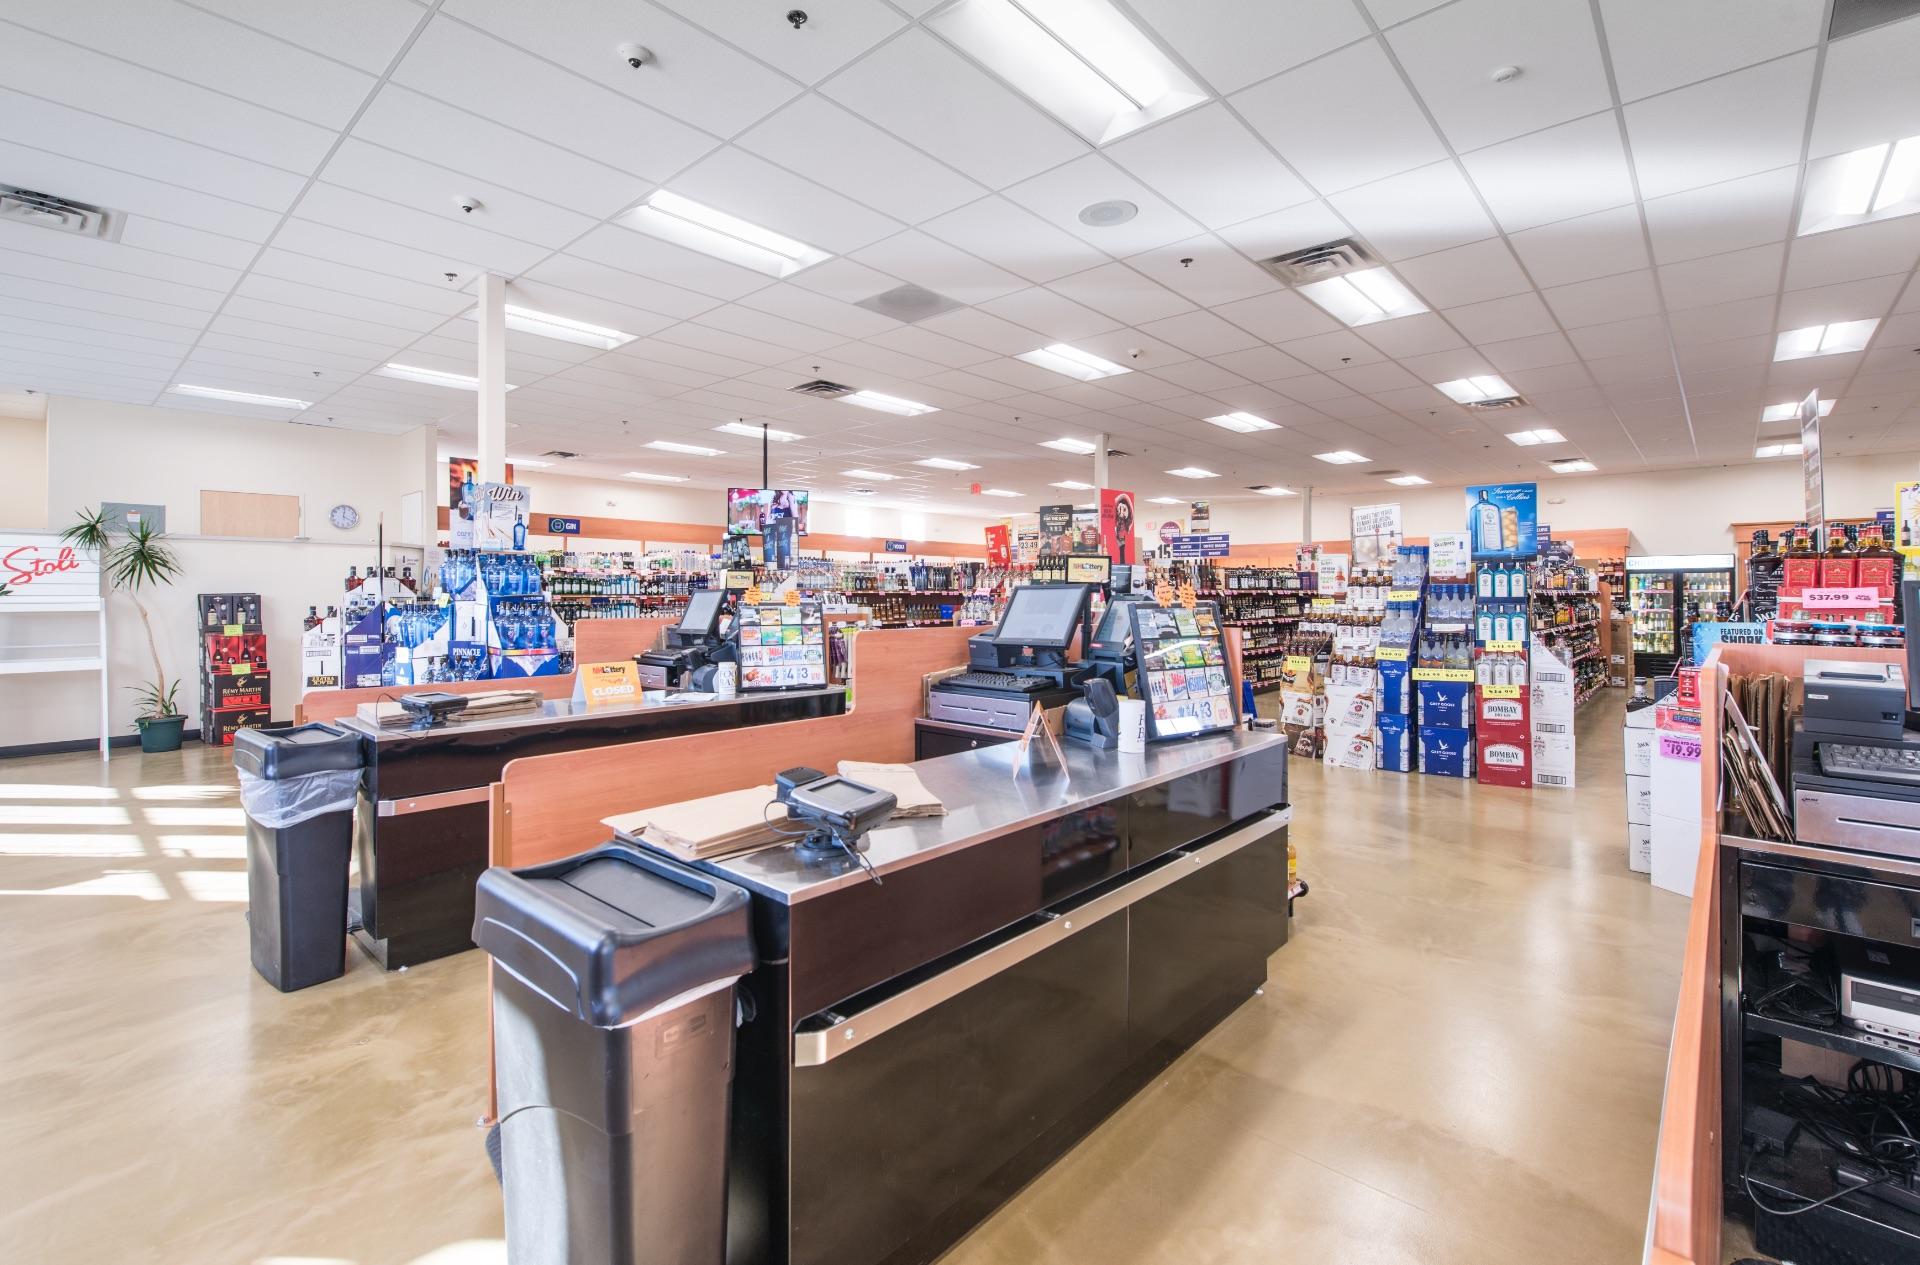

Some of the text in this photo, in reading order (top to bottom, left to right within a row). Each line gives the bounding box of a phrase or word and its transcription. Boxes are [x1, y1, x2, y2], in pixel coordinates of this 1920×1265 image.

[488, 486, 524, 501] Win
[3, 546, 79, 585] Stoli
[453, 648, 481, 656] PINNACLE
[787, 668, 794, 679] 4
[801, 668, 808, 679] 3
[592, 685, 634, 696] CLOSED
[1204, 702, 1212, 717] 3
[1488, 705, 1518, 714] BOMBAY
[1490, 750, 1519, 760] BOMBAY
[1667, 744, 1701, 758] $19.99
